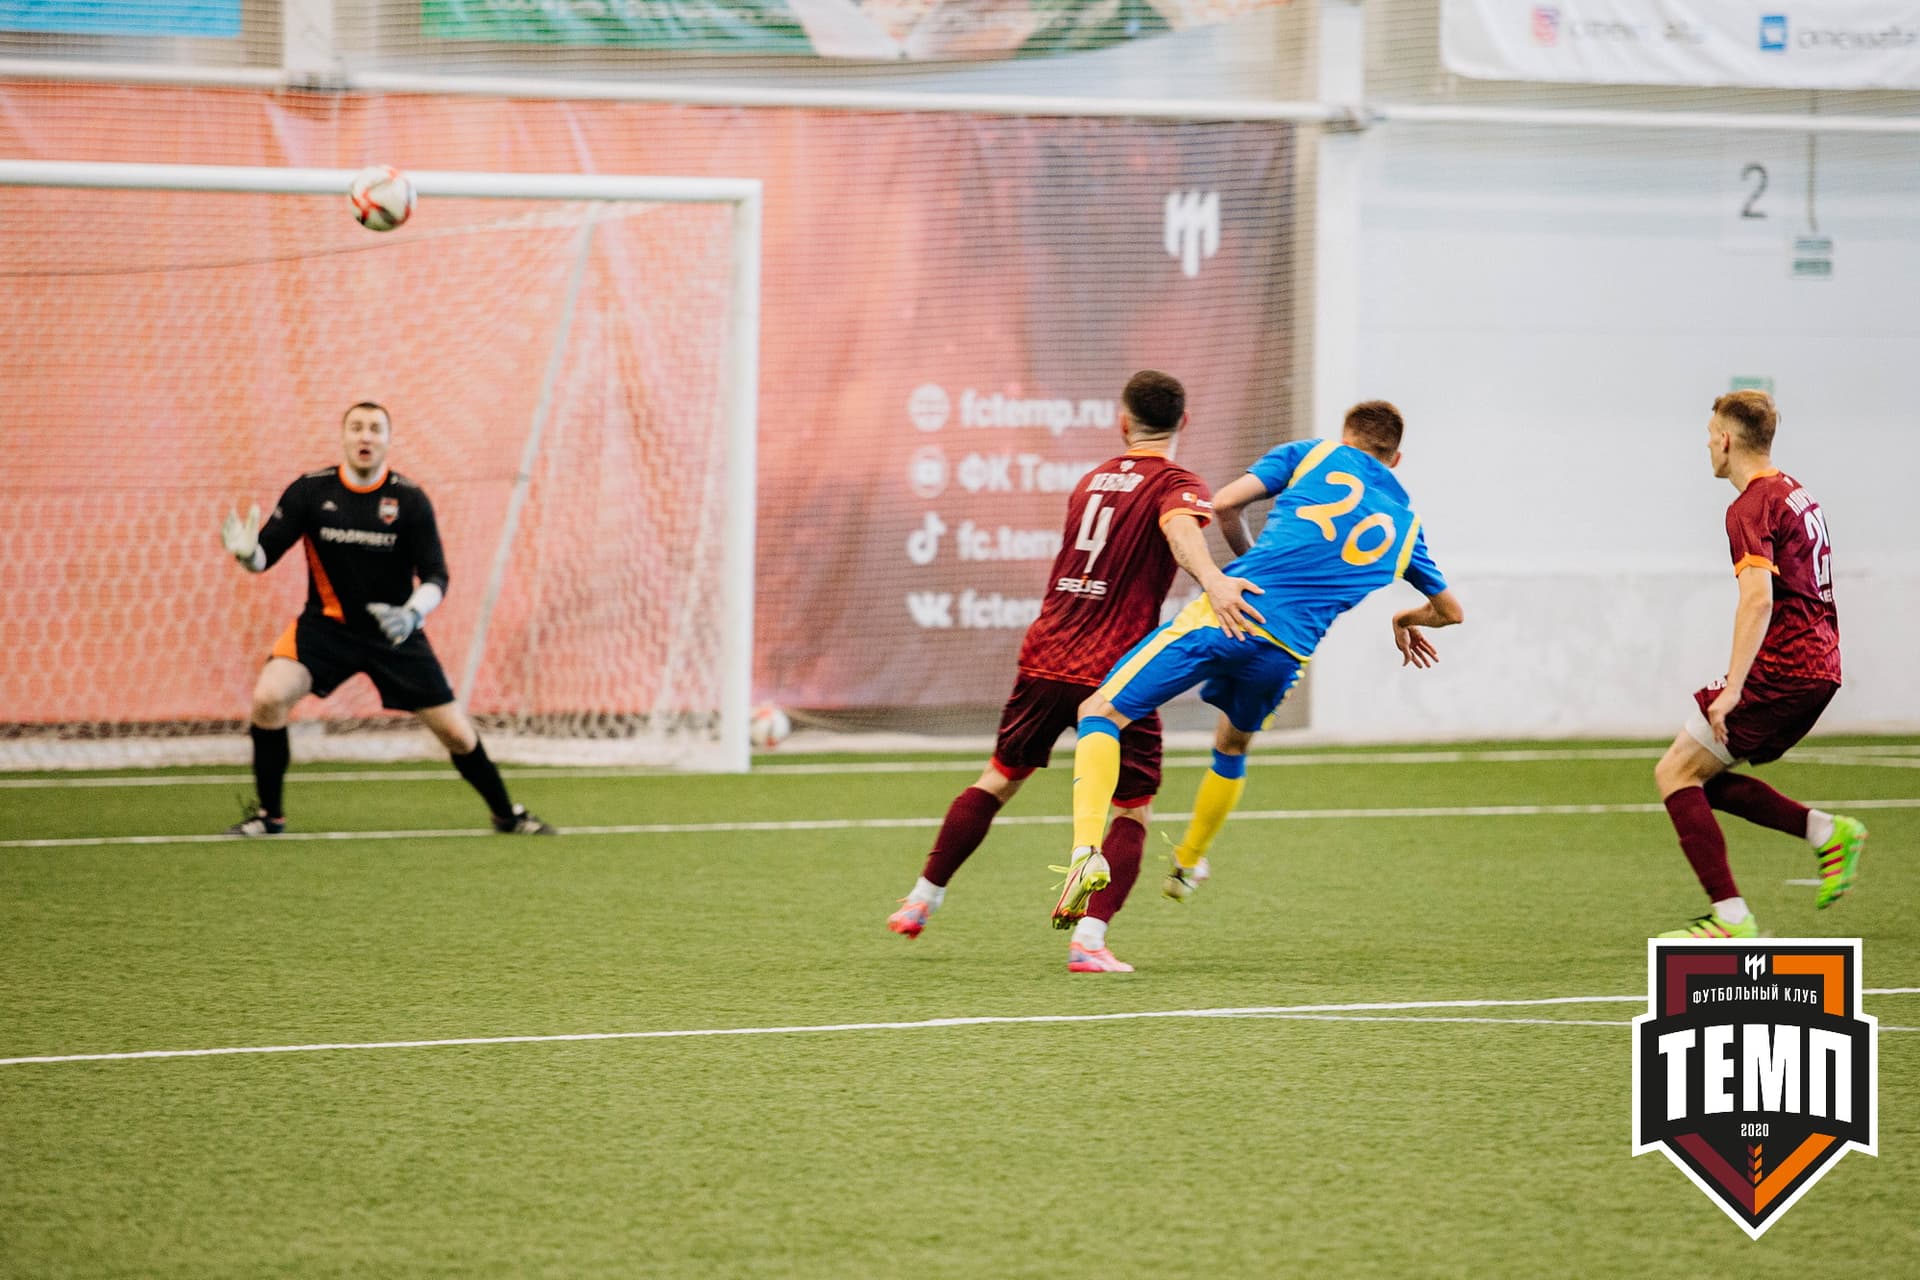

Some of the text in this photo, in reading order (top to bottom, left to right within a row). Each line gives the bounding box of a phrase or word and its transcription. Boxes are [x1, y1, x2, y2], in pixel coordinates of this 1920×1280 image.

[1740, 162, 1769, 219] 2
[960, 388, 1116, 436] fctemp.ru
[957, 453, 1013, 493] ФК
[1074, 493, 1115, 574] 4
[1295, 470, 1396, 566] 20
